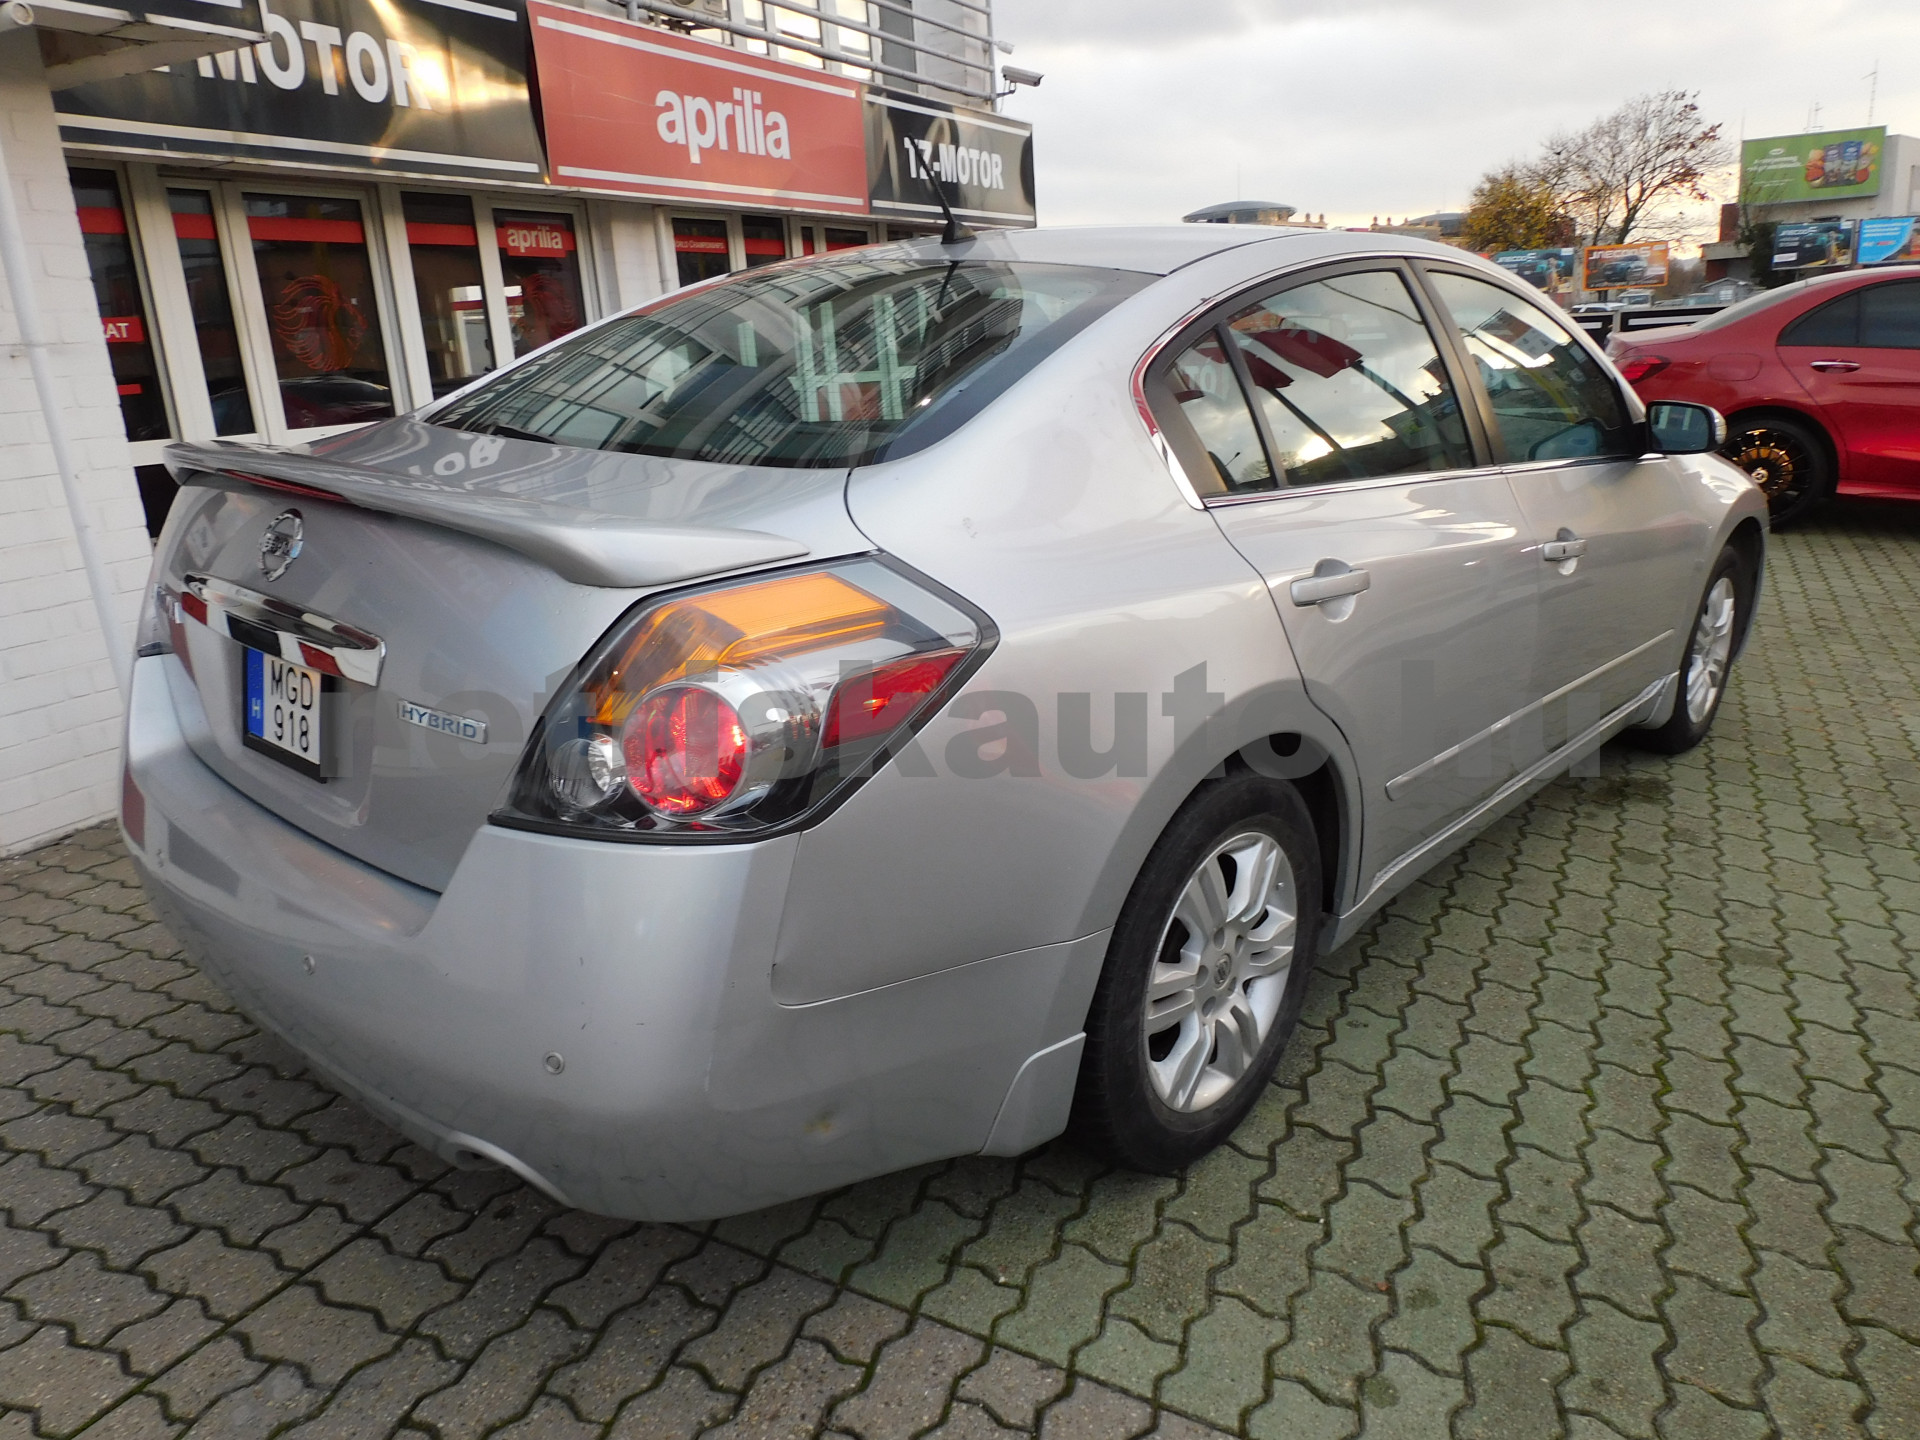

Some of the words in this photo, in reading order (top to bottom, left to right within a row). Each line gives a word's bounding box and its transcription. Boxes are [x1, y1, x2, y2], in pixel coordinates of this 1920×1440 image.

[655, 87, 791, 164] aprilia
[507, 225, 563, 253] aprilia
[104, 322, 130, 339] AT
[270, 660, 314, 711] MGD
[251, 697, 262, 719] H
[401, 704, 478, 740] HYBRID
[274, 704, 310, 754] 918
